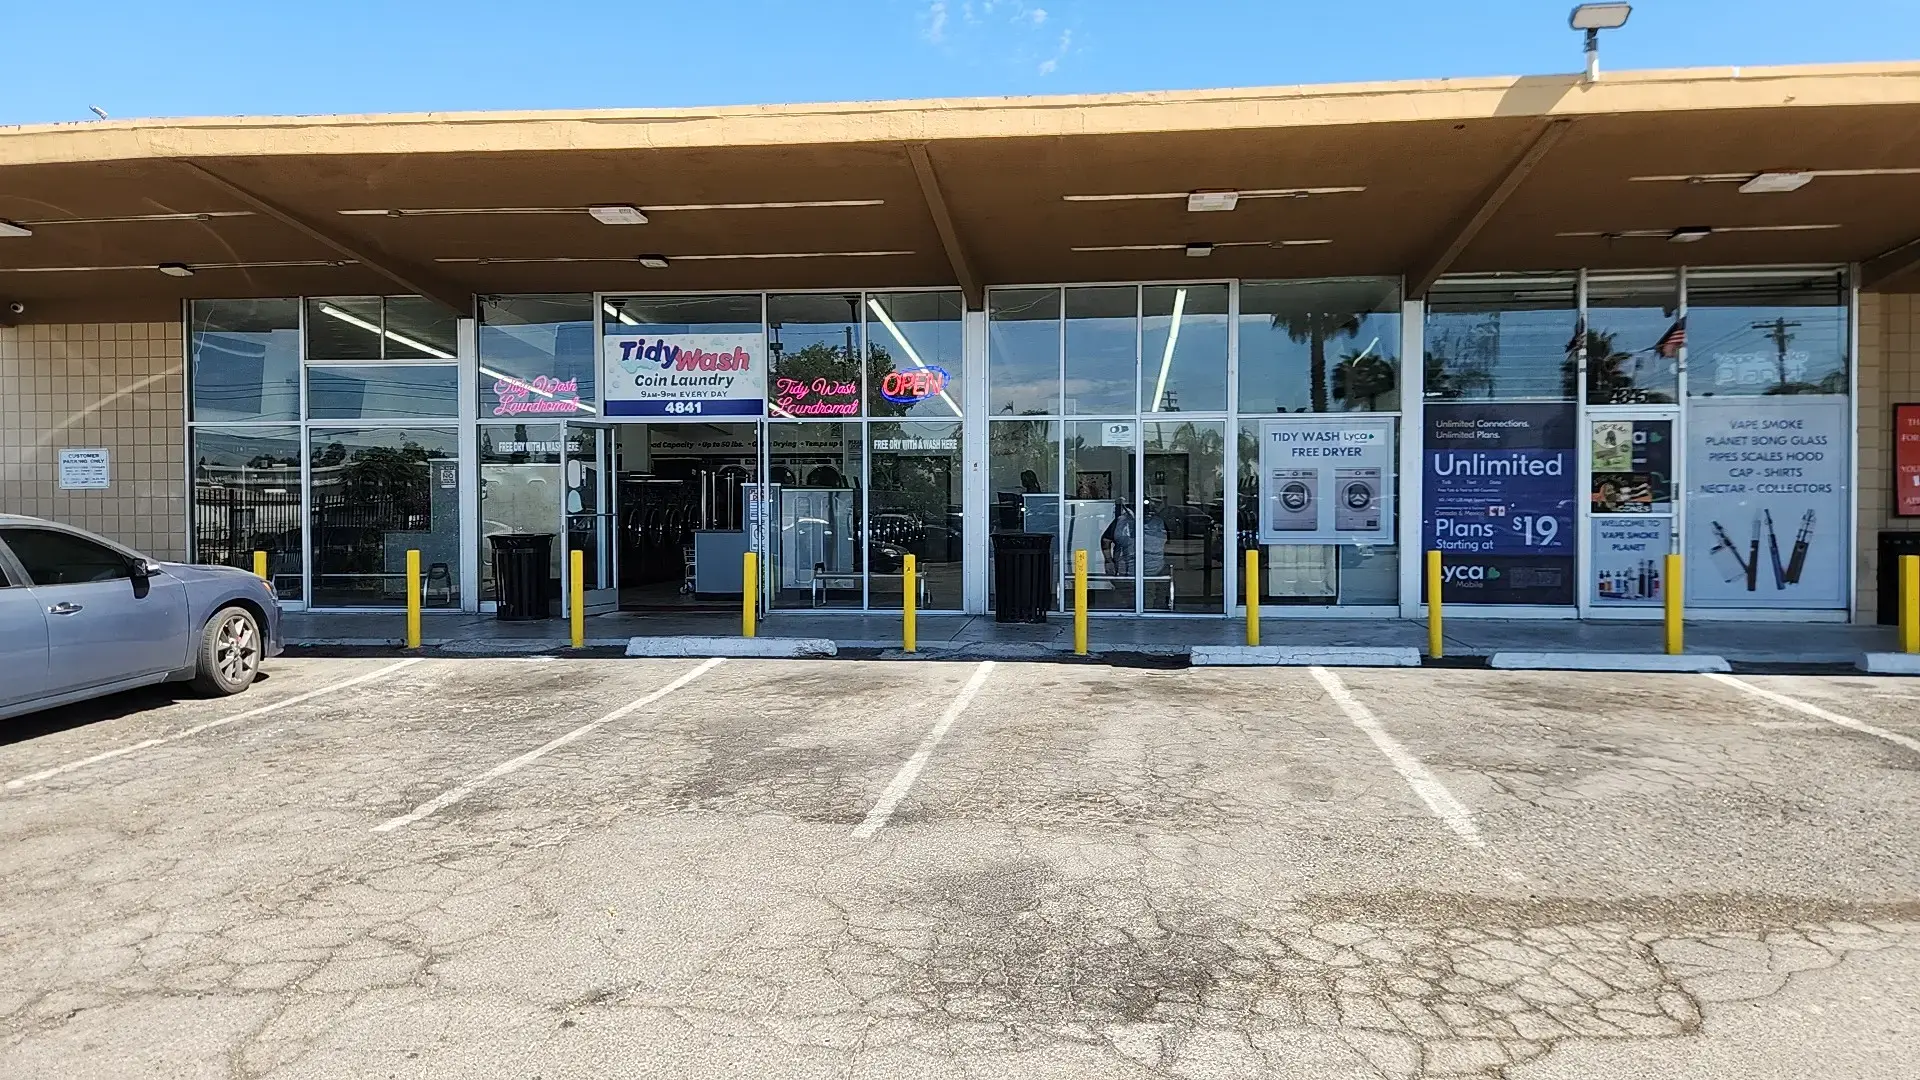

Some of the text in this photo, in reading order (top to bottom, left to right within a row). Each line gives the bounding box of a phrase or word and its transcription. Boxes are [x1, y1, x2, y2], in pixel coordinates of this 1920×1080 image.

[533, 375, 578, 394] Wash
[634, 373, 735, 389] Coin Laundry
[882, 371, 944, 397] OPEN
[776, 376, 857, 400] Tidy Wash
[679, 390, 709, 398] EVERY
[710, 390, 728, 398] DAY
[493, 394, 580, 416] Laundromat
[664, 401, 702, 414] 4841
[772, 396, 859, 416] Laundromat
[1435, 419, 1530, 428] Unlimited Connections.
[1728, 419, 1804, 430] VAPE SMOKE
[1271, 431, 1368, 442] TIDY WASH Lyca
[1435, 430, 1501, 439] Unlimited Plans.
[662, 441, 694, 450] Capacity
[701, 441, 712, 449] Up
[772, 440, 797, 449] Drying
[873, 439, 889, 451] FREE
[889, 439, 901, 450] DRY
[923, 439, 940, 450] WASH
[940, 439, 958, 451] HERE
[1705, 435, 1828, 446] PLANET BONG GLASS
[498, 441, 513, 452] FREE
[513, 441, 526, 452] DRY
[566, 441, 580, 452] ERE
[1292, 447, 1362, 457] FREE DRYER
[1709, 452, 1824, 462] PIPES SCALES HOOD
[1434, 453, 1562, 476] Unlimited
[1728, 468, 1754, 478] CAP
[1764, 467, 1803, 478] SHIRTS
[1700, 484, 1746, 494] NECTAR
[1756, 483, 1832, 494] COLLECTORS
[1435, 515, 1559, 546] Plans $19
[1435, 538, 1494, 552] Starting at
[1612, 543, 1647, 551] PLANET
[1441, 565, 1484, 583] yca
[1455, 580, 1484, 588] Mobile
